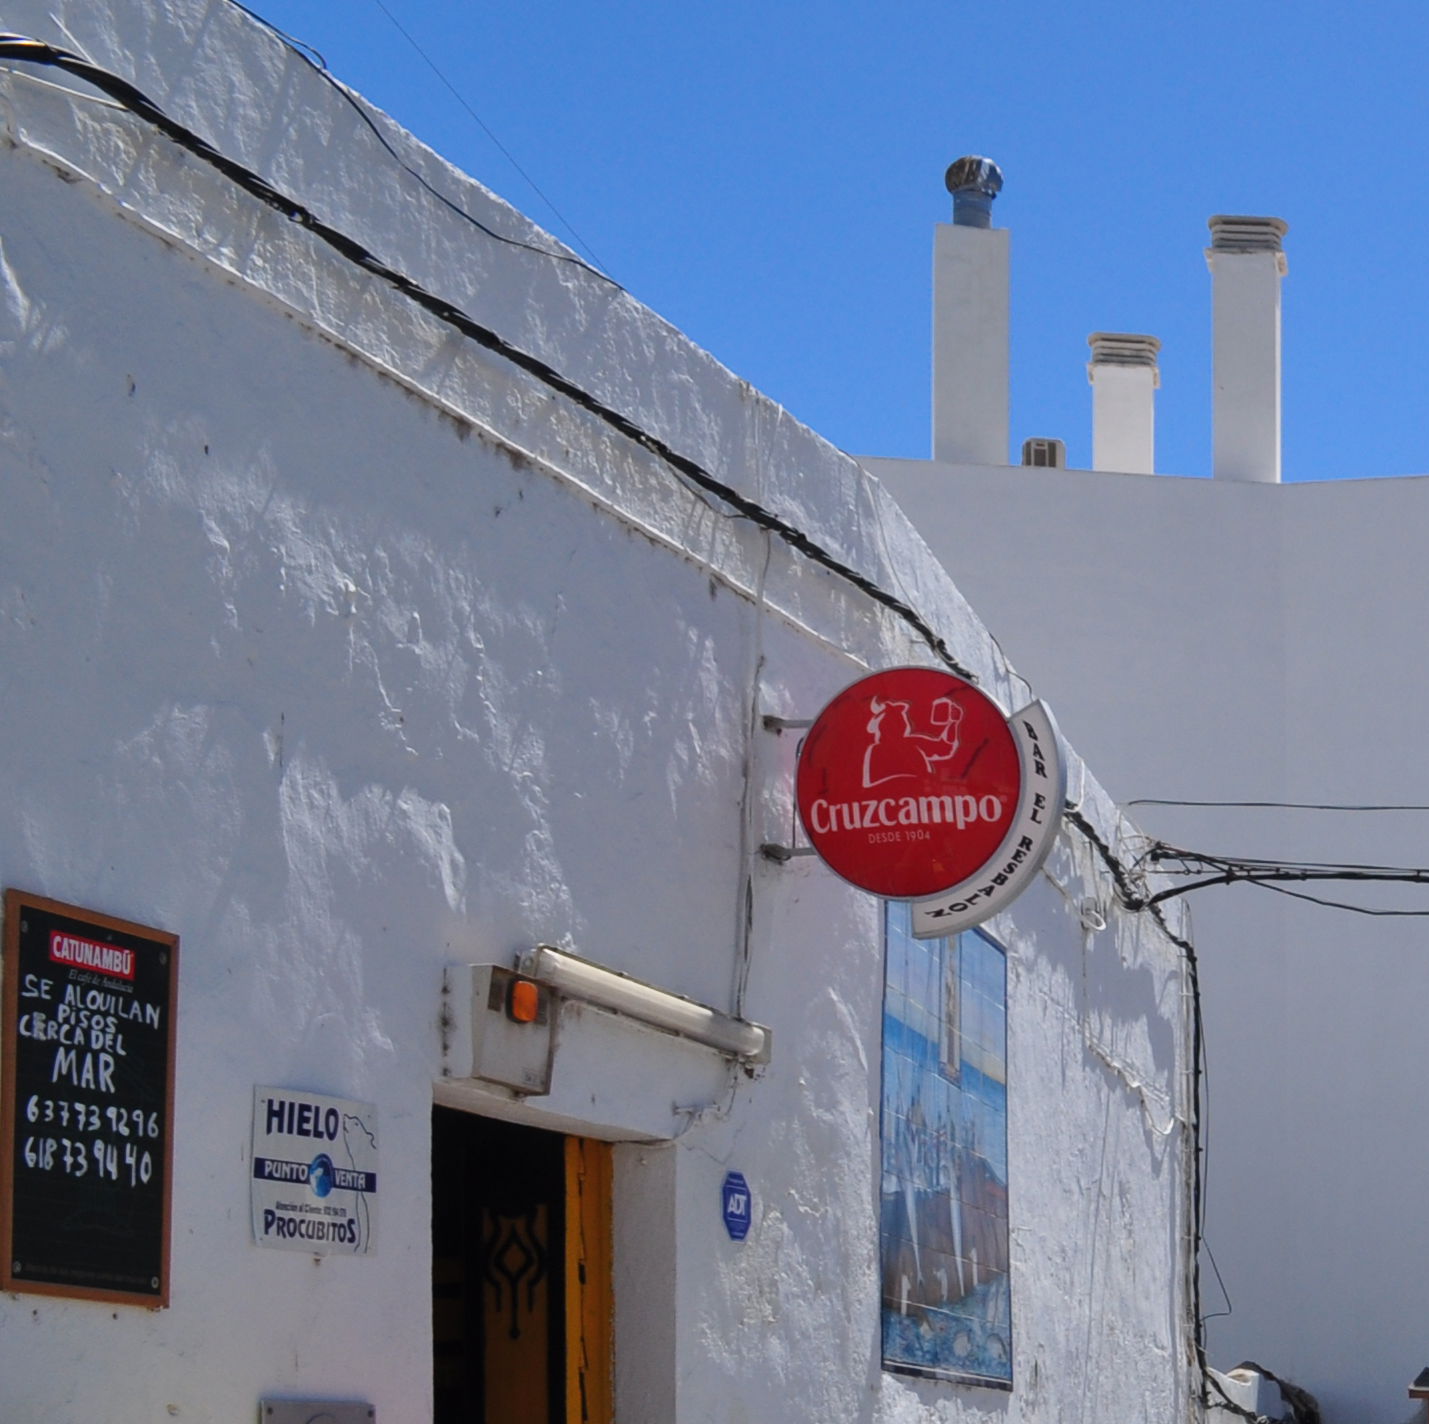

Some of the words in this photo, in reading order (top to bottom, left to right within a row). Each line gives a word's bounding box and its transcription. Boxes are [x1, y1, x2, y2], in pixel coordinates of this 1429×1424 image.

[1023, 720, 1047, 778] BAR
[811, 794, 1003, 833] Cruzcampo
[1030, 793, 1046, 825] EL
[868, 831, 901, 844] DESDE
[905, 830, 931, 842] 1904
[924, 835, 1033, 918] RESBALON
[21, 974, 53, 999] SE
[19, 1011, 85, 1045] CERCA
[91, 1029, 127, 1056] DEL
[52, 1046, 116, 1093] MAR
[266, 1099, 339, 1141] HIELO
[264, 1160, 308, 1181] PUNTO
[335, 1169, 366, 1189] VENTA
[264, 1208, 356, 1244] PROCUBITOS
